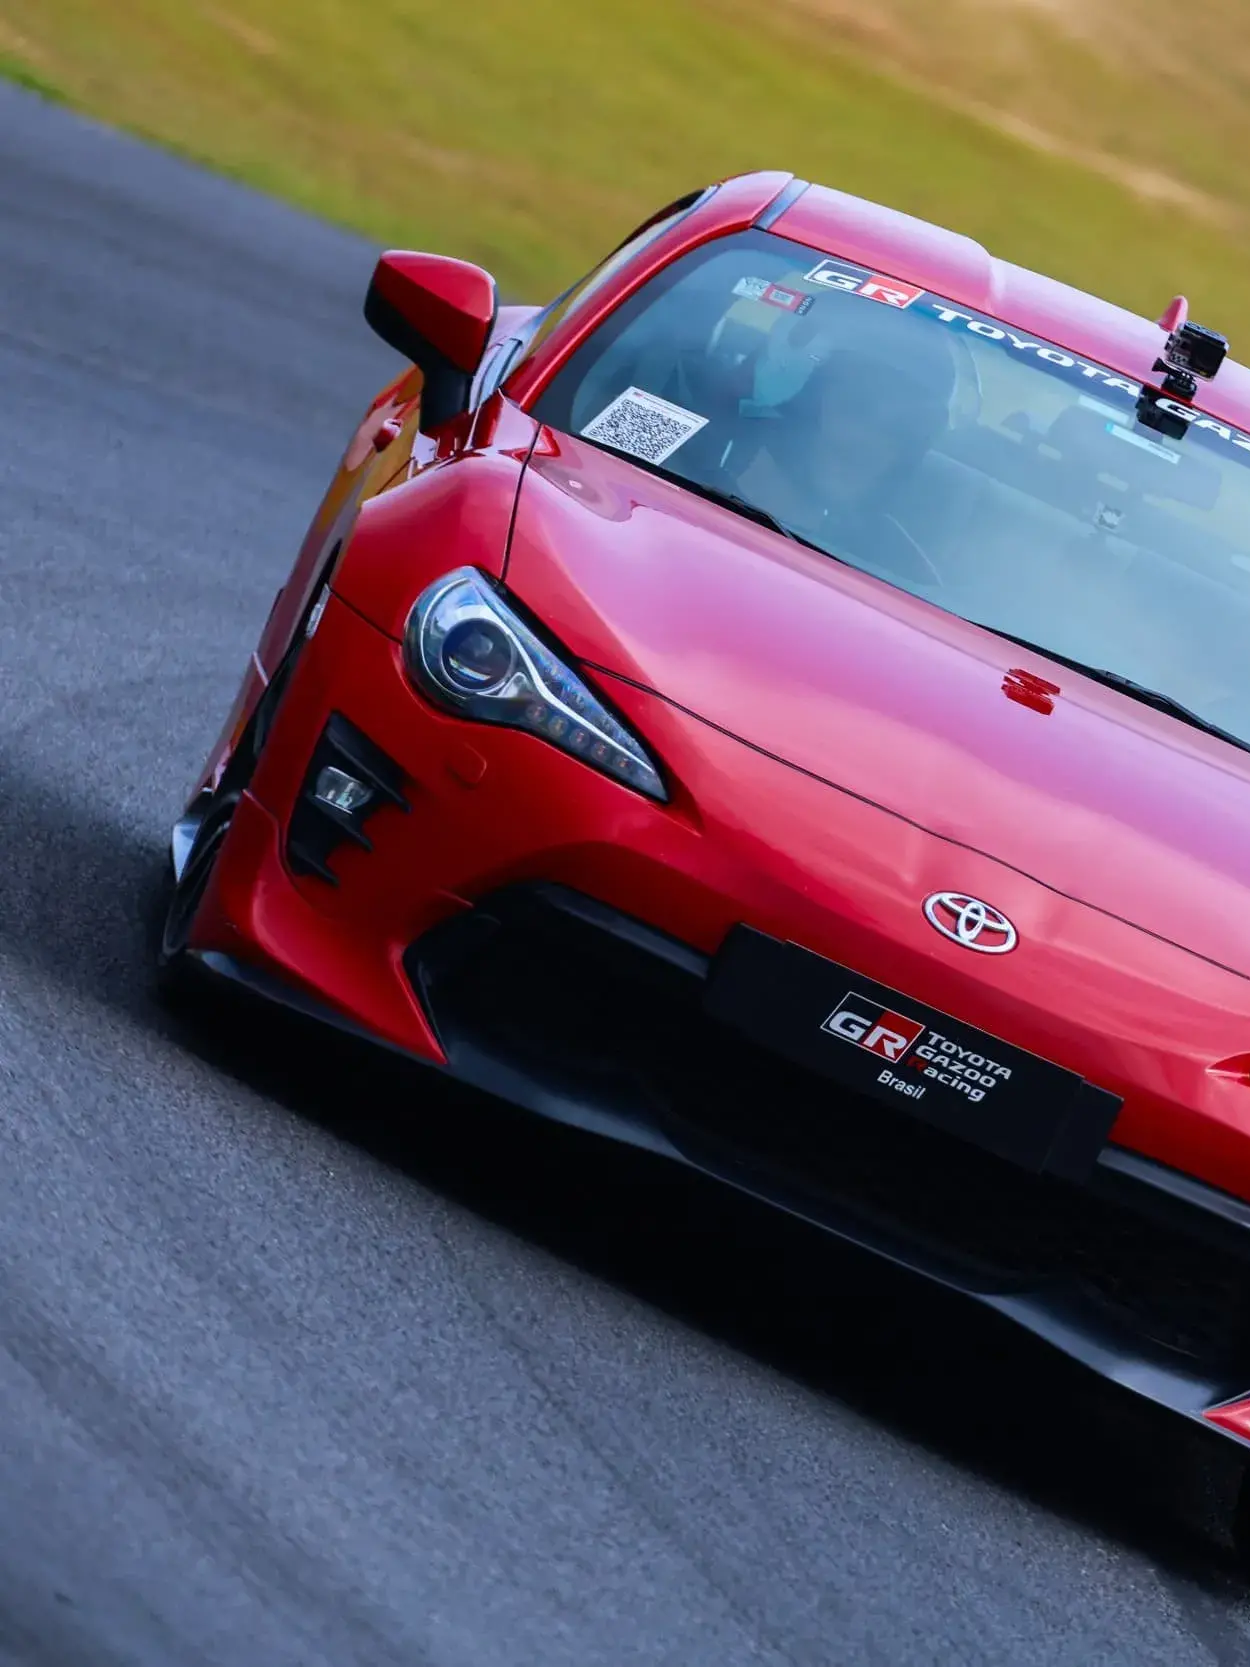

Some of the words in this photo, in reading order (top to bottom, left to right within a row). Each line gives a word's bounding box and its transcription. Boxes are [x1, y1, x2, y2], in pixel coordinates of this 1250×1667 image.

[812, 269, 913, 307] GR
[931, 303, 1141, 398] TOYOTA
[828, 1011, 907, 1059] GR
[927, 1031, 1012, 1080] TOYOTA
[877, 1069, 926, 1100] Brasil
[906, 1056, 987, 1102] Racing
[915, 1045, 997, 1088] GAZOO
